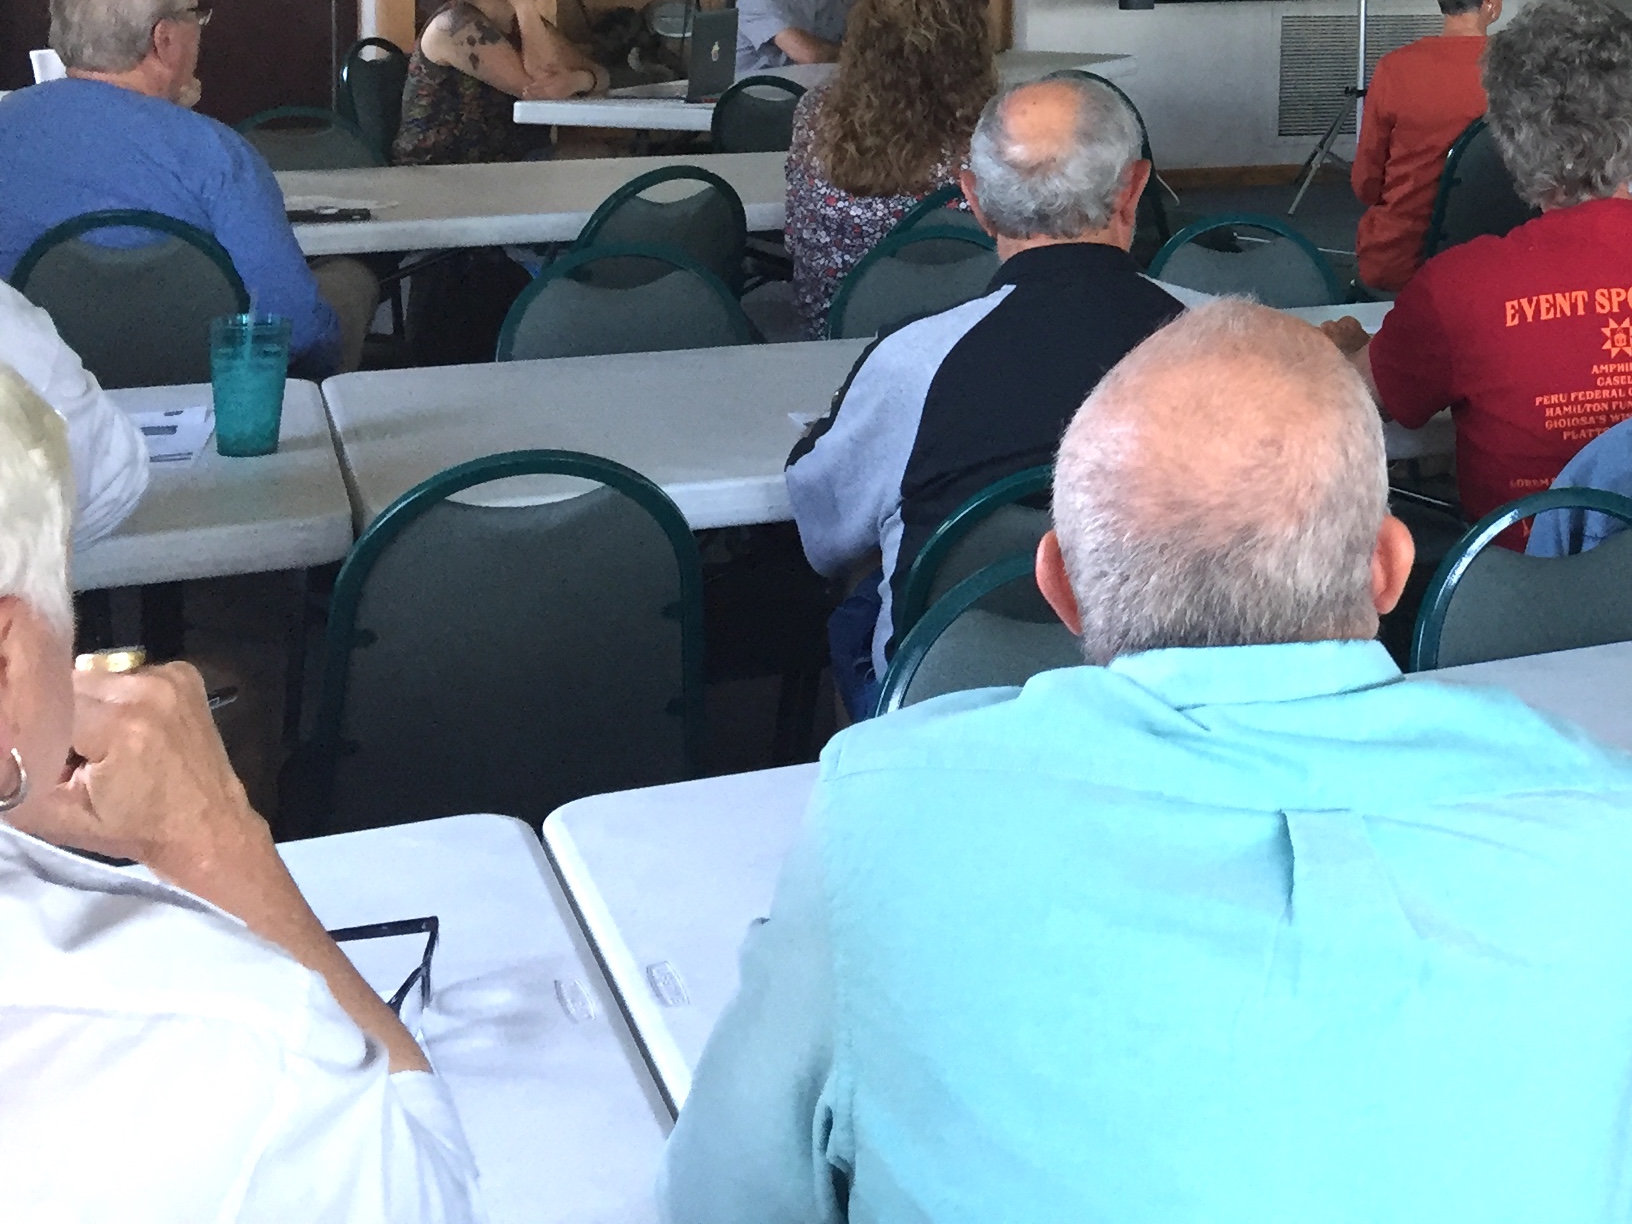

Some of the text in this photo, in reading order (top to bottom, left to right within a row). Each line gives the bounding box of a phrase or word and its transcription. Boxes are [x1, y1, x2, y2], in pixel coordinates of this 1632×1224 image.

[1505, 290, 1588, 326] EVENT
[1535, 393, 1568, 406] PERU
[1570, 389, 1626, 402] FEDERAL
[1545, 402, 1609, 417] HAMILTON
